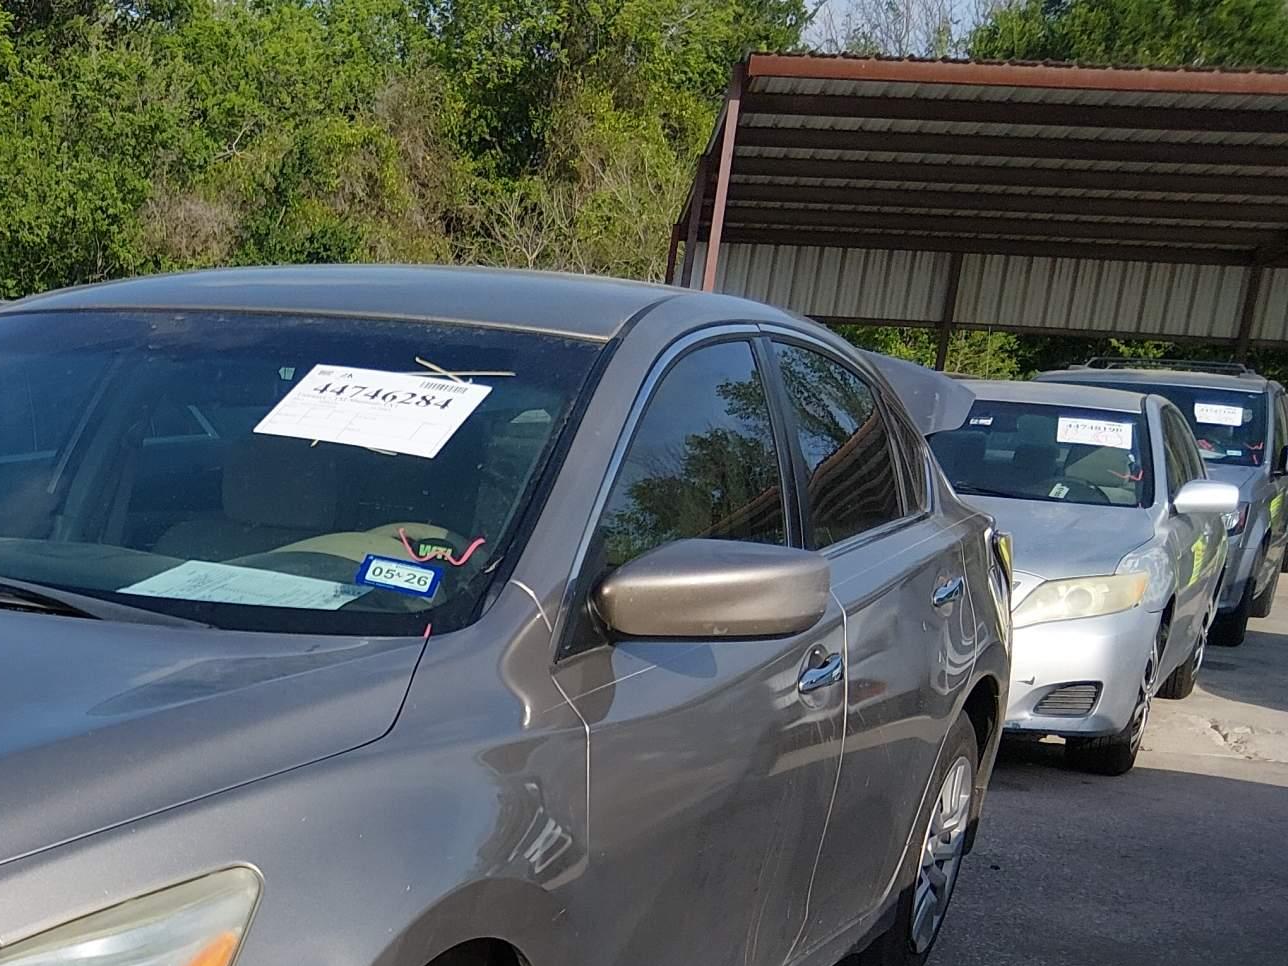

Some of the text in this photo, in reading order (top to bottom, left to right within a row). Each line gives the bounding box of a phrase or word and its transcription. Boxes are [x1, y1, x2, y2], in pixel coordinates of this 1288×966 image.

[313, 382, 453, 410] 44746284
[372, 566, 429, 587] 05 26
